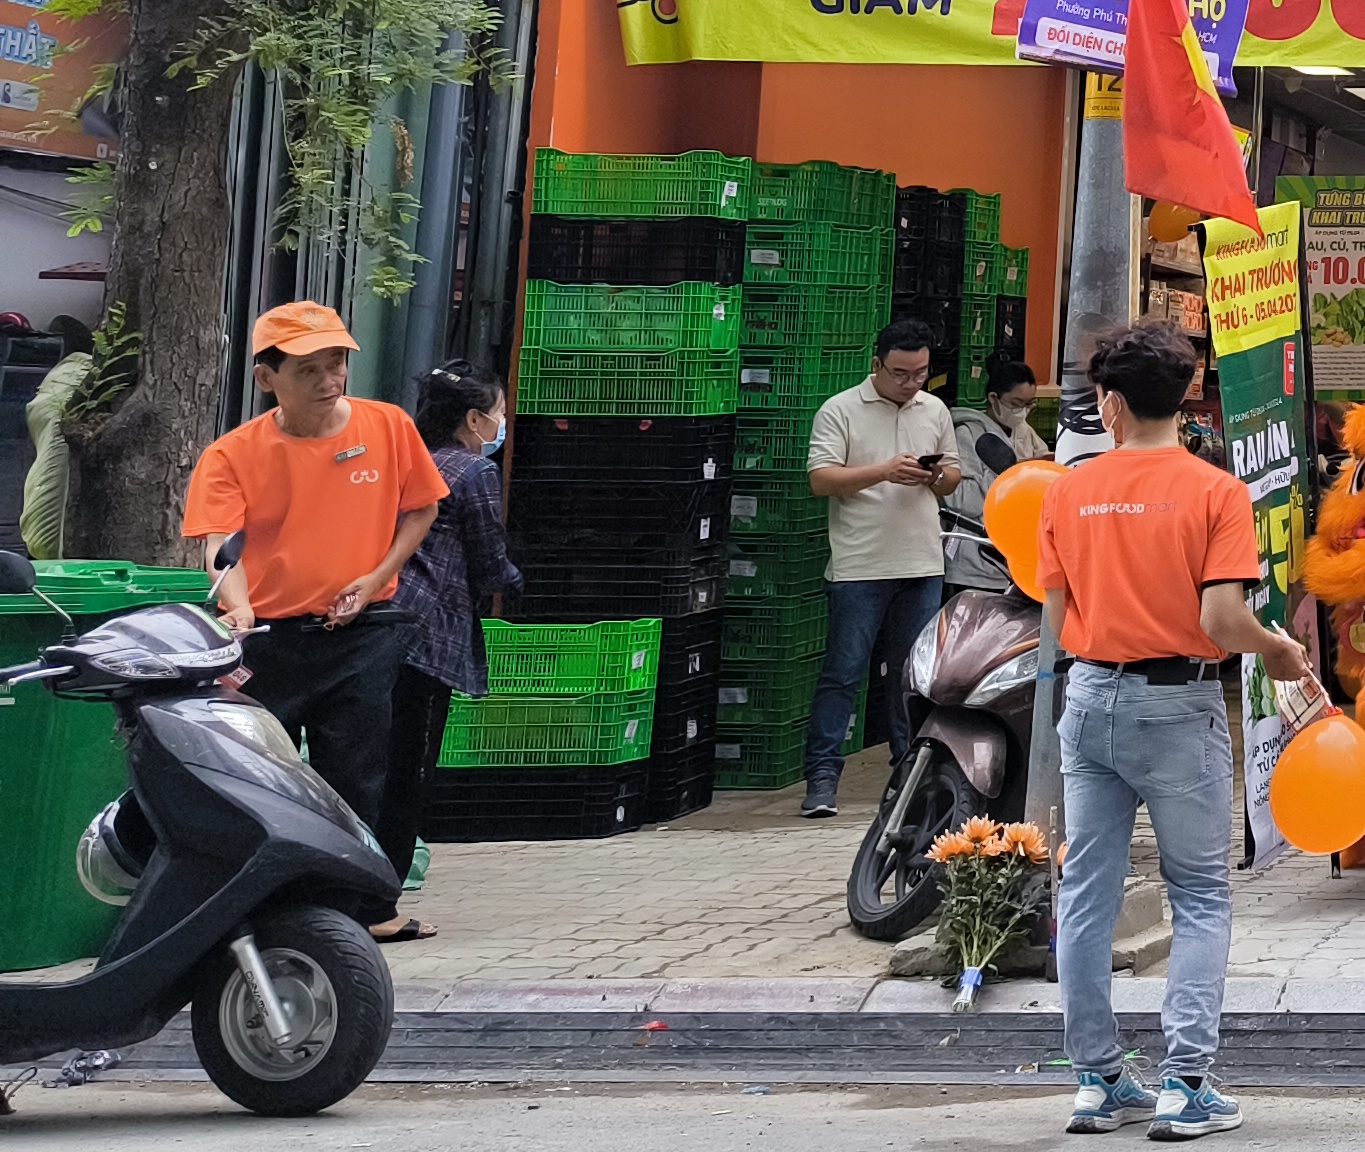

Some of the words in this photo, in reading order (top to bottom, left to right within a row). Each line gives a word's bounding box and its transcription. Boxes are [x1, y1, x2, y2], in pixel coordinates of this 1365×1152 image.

[1093, 3, 1114, 24] Phú
[1047, 24, 1071, 43] ĐỐI
[1072, 31, 1103, 52] DIỆN
[1210, 267, 1247, 304] KHAI
[1241, 307, 1248, 326] 6
